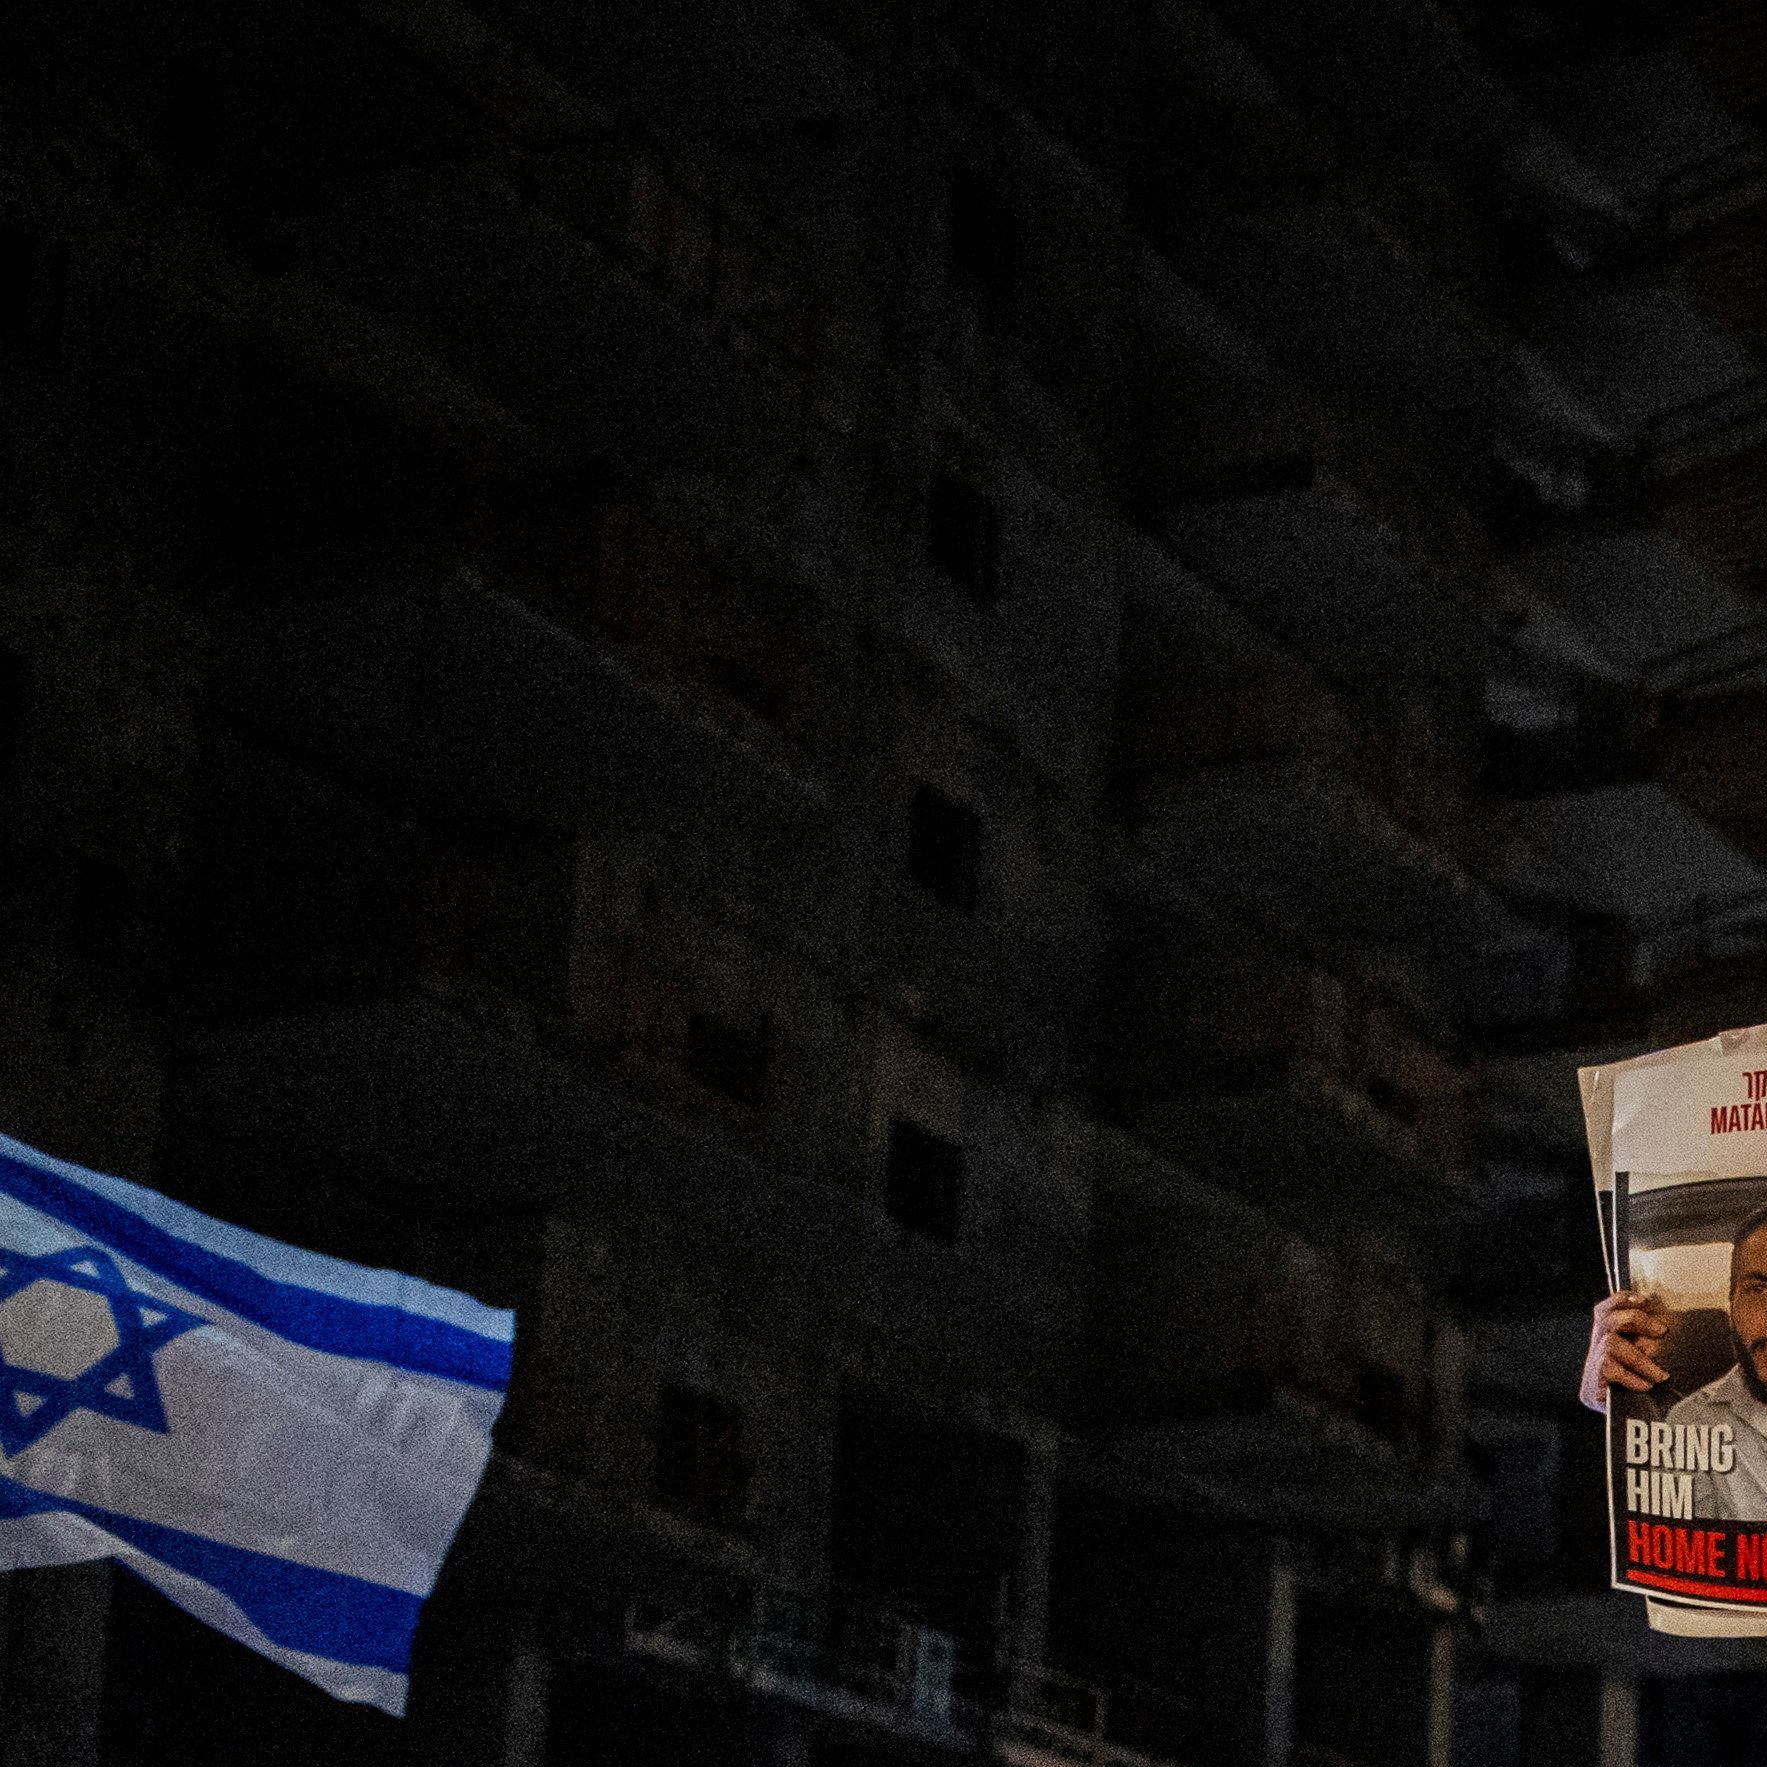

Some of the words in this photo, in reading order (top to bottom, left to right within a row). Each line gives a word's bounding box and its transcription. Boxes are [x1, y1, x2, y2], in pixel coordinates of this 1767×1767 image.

[1626, 1418, 1736, 1473] BRING
[1626, 1468, 1696, 1520] HIM
[1627, 1520, 1725, 1577] HOME
